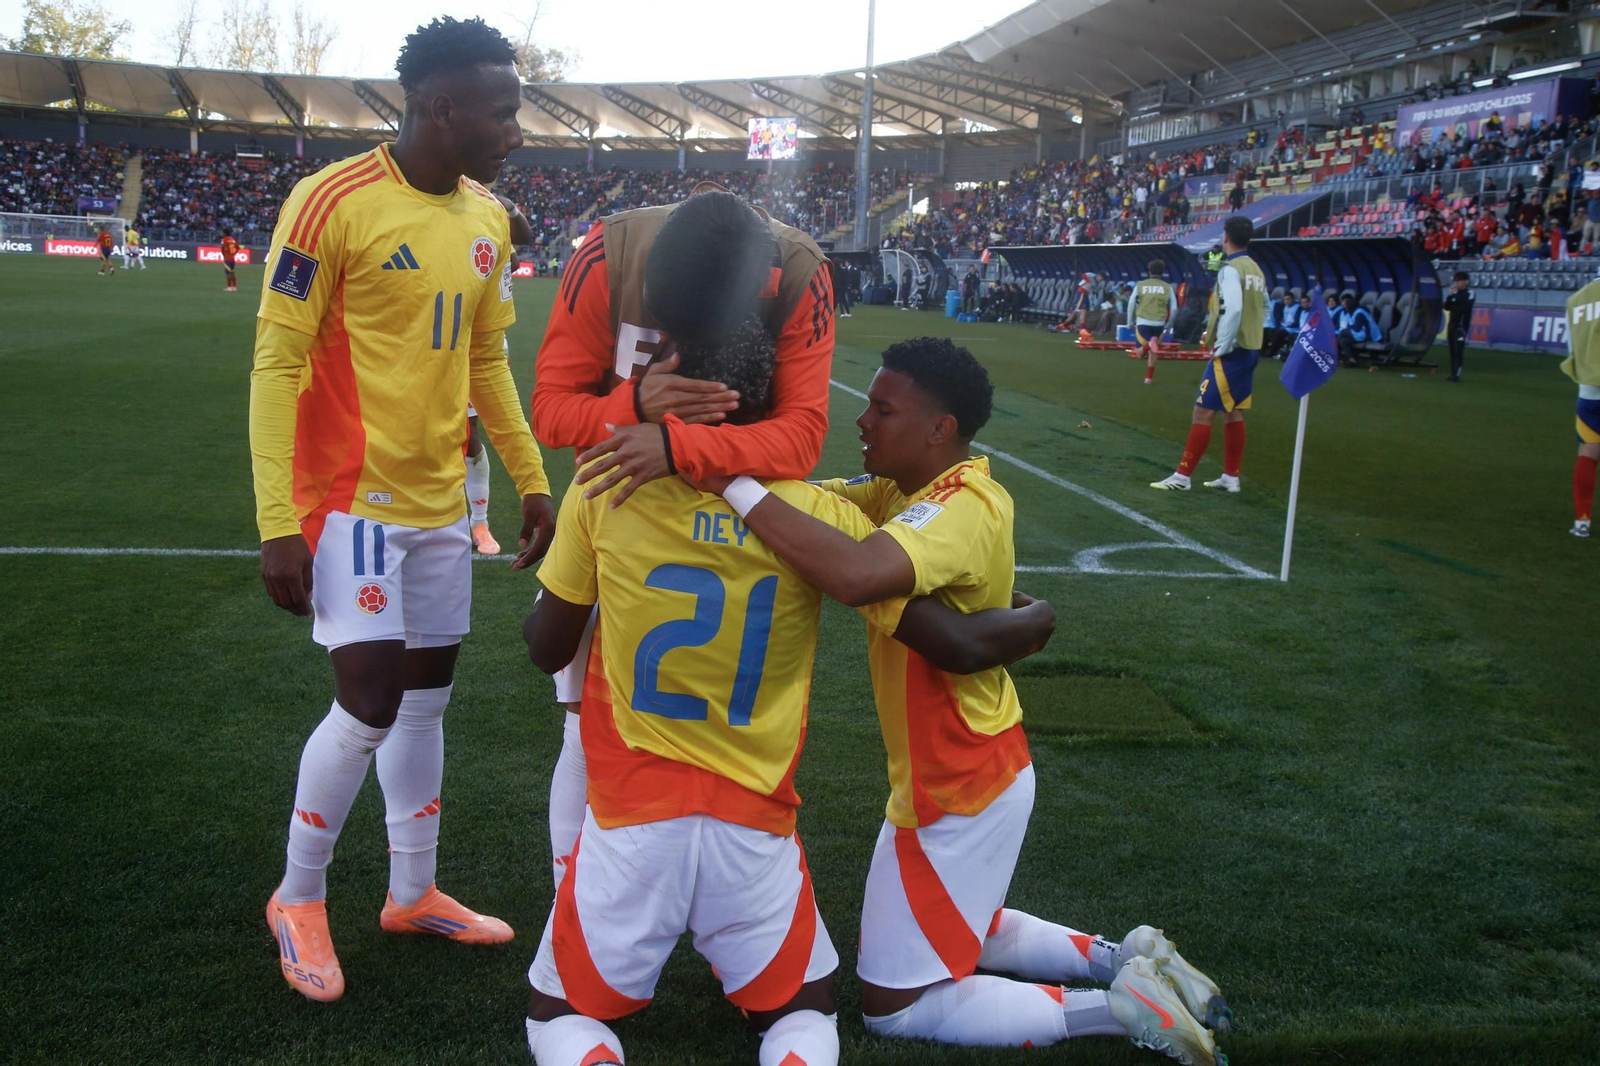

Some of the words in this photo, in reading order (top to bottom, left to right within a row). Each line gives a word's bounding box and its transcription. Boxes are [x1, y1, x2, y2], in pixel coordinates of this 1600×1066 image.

[1444, 104, 1468, 117] WORLD
[1469, 101, 1485, 113] CUP
[48, 242, 98, 255] Lenovo
[138, 246, 188, 259] olutions
[200, 248, 248, 262] Lenvo
[1142, 285, 1165, 295] FIFA
[431, 290, 463, 351] 11
[353, 518, 386, 576] 11
[631, 563, 779, 727] 21
[283, 963, 325, 990] F50
